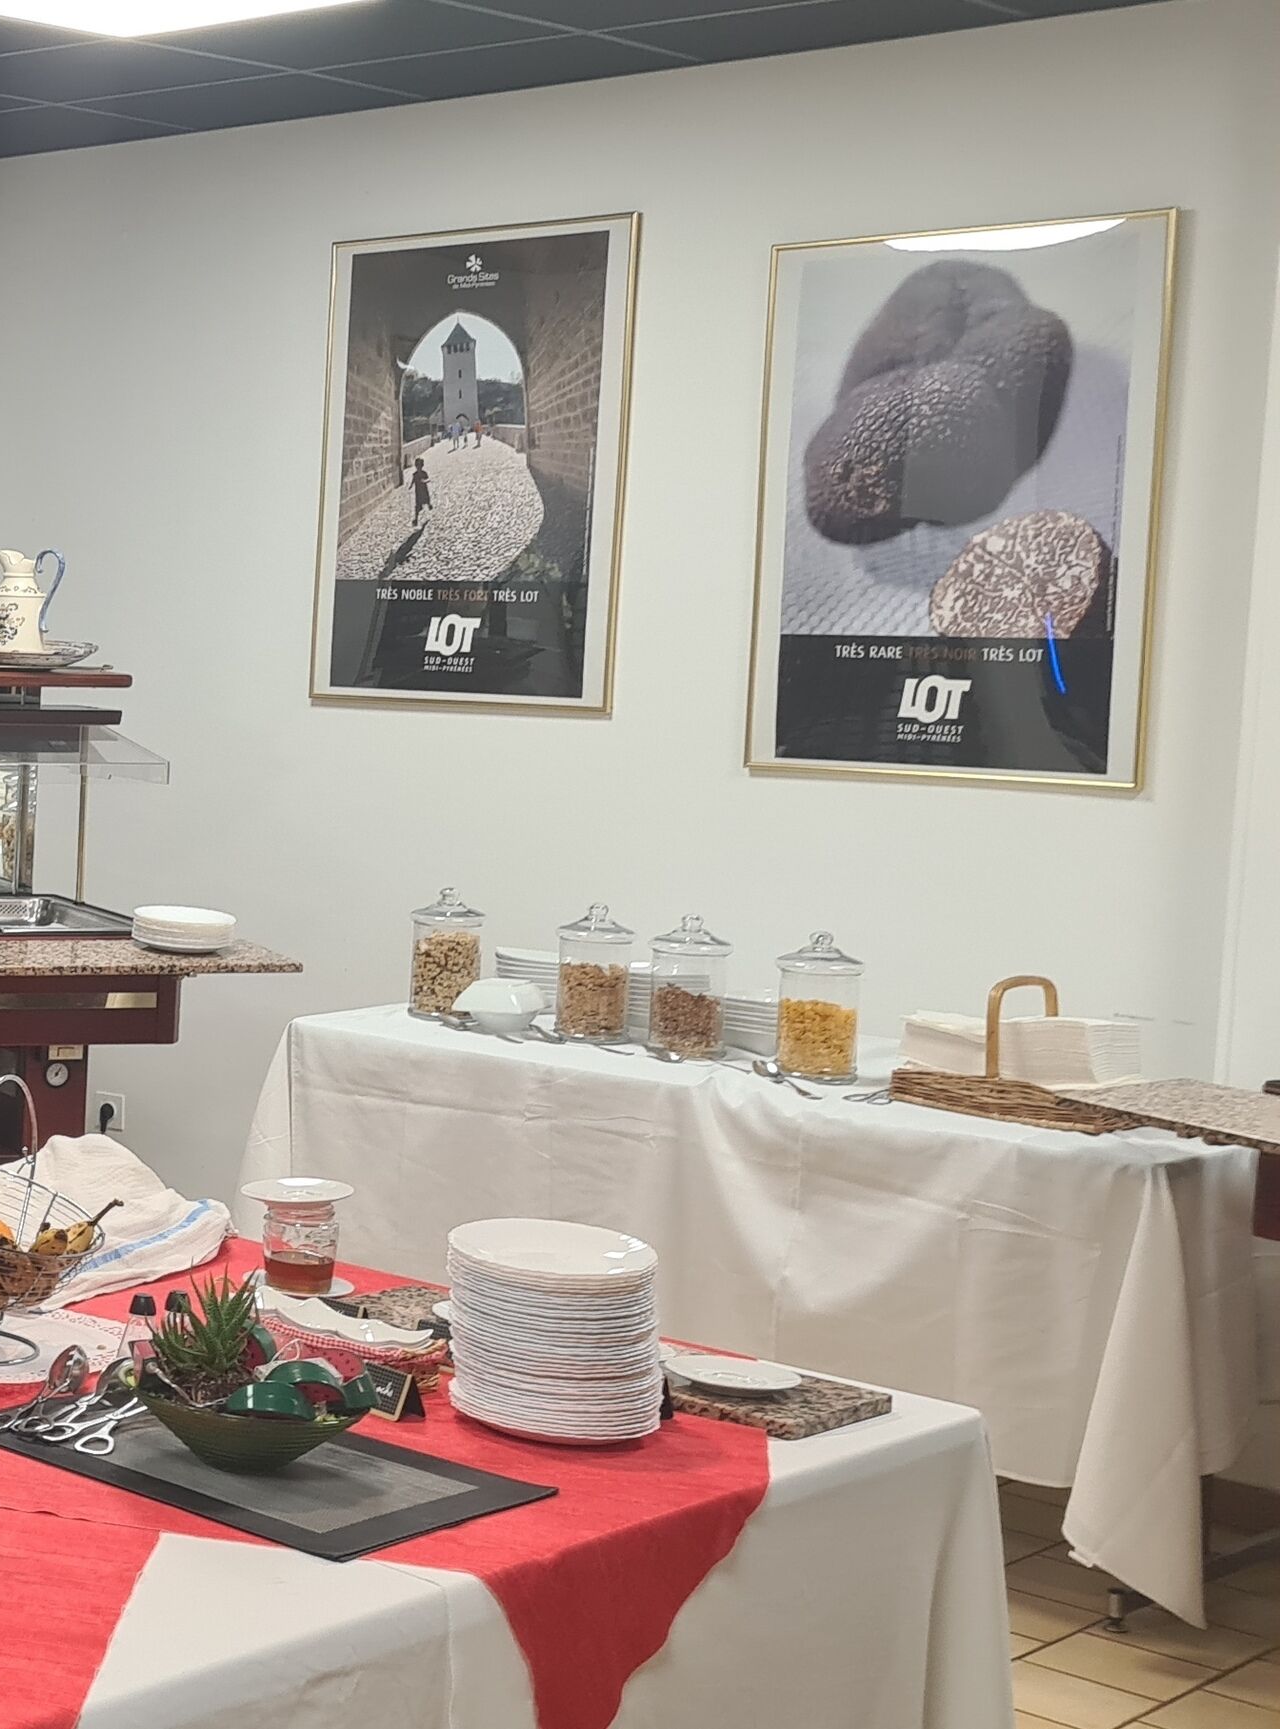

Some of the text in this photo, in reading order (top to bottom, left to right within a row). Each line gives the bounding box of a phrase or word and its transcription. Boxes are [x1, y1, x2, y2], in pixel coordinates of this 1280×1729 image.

[447, 273, 477, 284] Grands
[376, 585, 398, 600] TRÈS
[401, 588, 434, 601] NOBLE
[463, 588, 490, 602] FORT
[492, 587, 517, 602] TRÈS
[520, 590, 540, 603] LOT
[425, 614, 481, 656] LOT
[424, 656, 474, 665] SUD-OUEST
[835, 642, 865, 659] TRÈS
[869, 645, 903, 660] RARE
[981, 645, 1014, 662] TRÈS
[1018, 648, 1045, 663] LOT
[897, 674, 972, 724] LOT
[897, 724, 964, 734] SUD-OUEST
